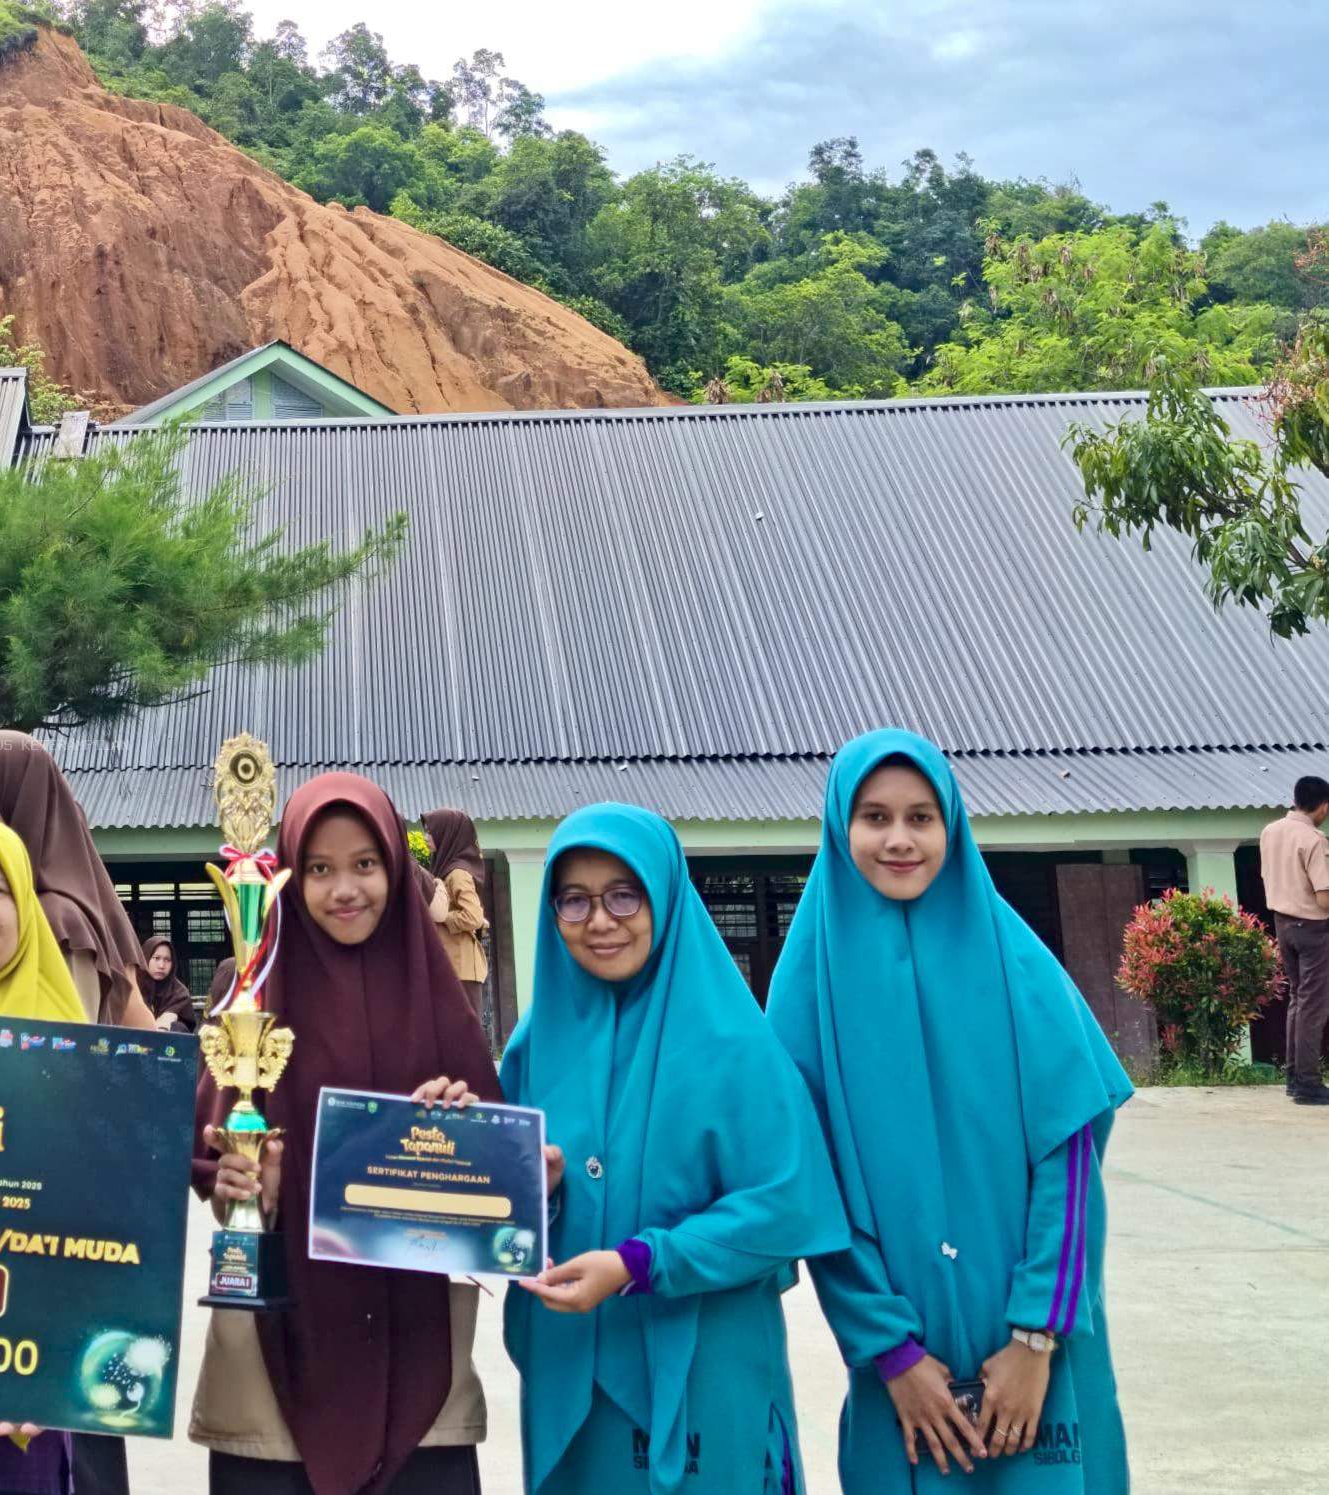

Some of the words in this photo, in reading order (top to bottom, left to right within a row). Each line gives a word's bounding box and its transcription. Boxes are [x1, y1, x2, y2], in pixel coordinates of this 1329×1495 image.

[410, 1125, 446, 1144] Pesta
[400, 1138, 456, 1157] Tapanuli
[367, 1166, 419, 1180] SERTIFIKAT
[420, 1168, 491, 1185] PENGHARGAAN
[2, 1195, 31, 1210] 2025
[63, 1237, 141, 1265] MUDA
[219, 1276, 245, 1287] JUARA
[632, 1428, 701, 1457] MN
[1033, 1449, 1081, 1466] SIBOLG
